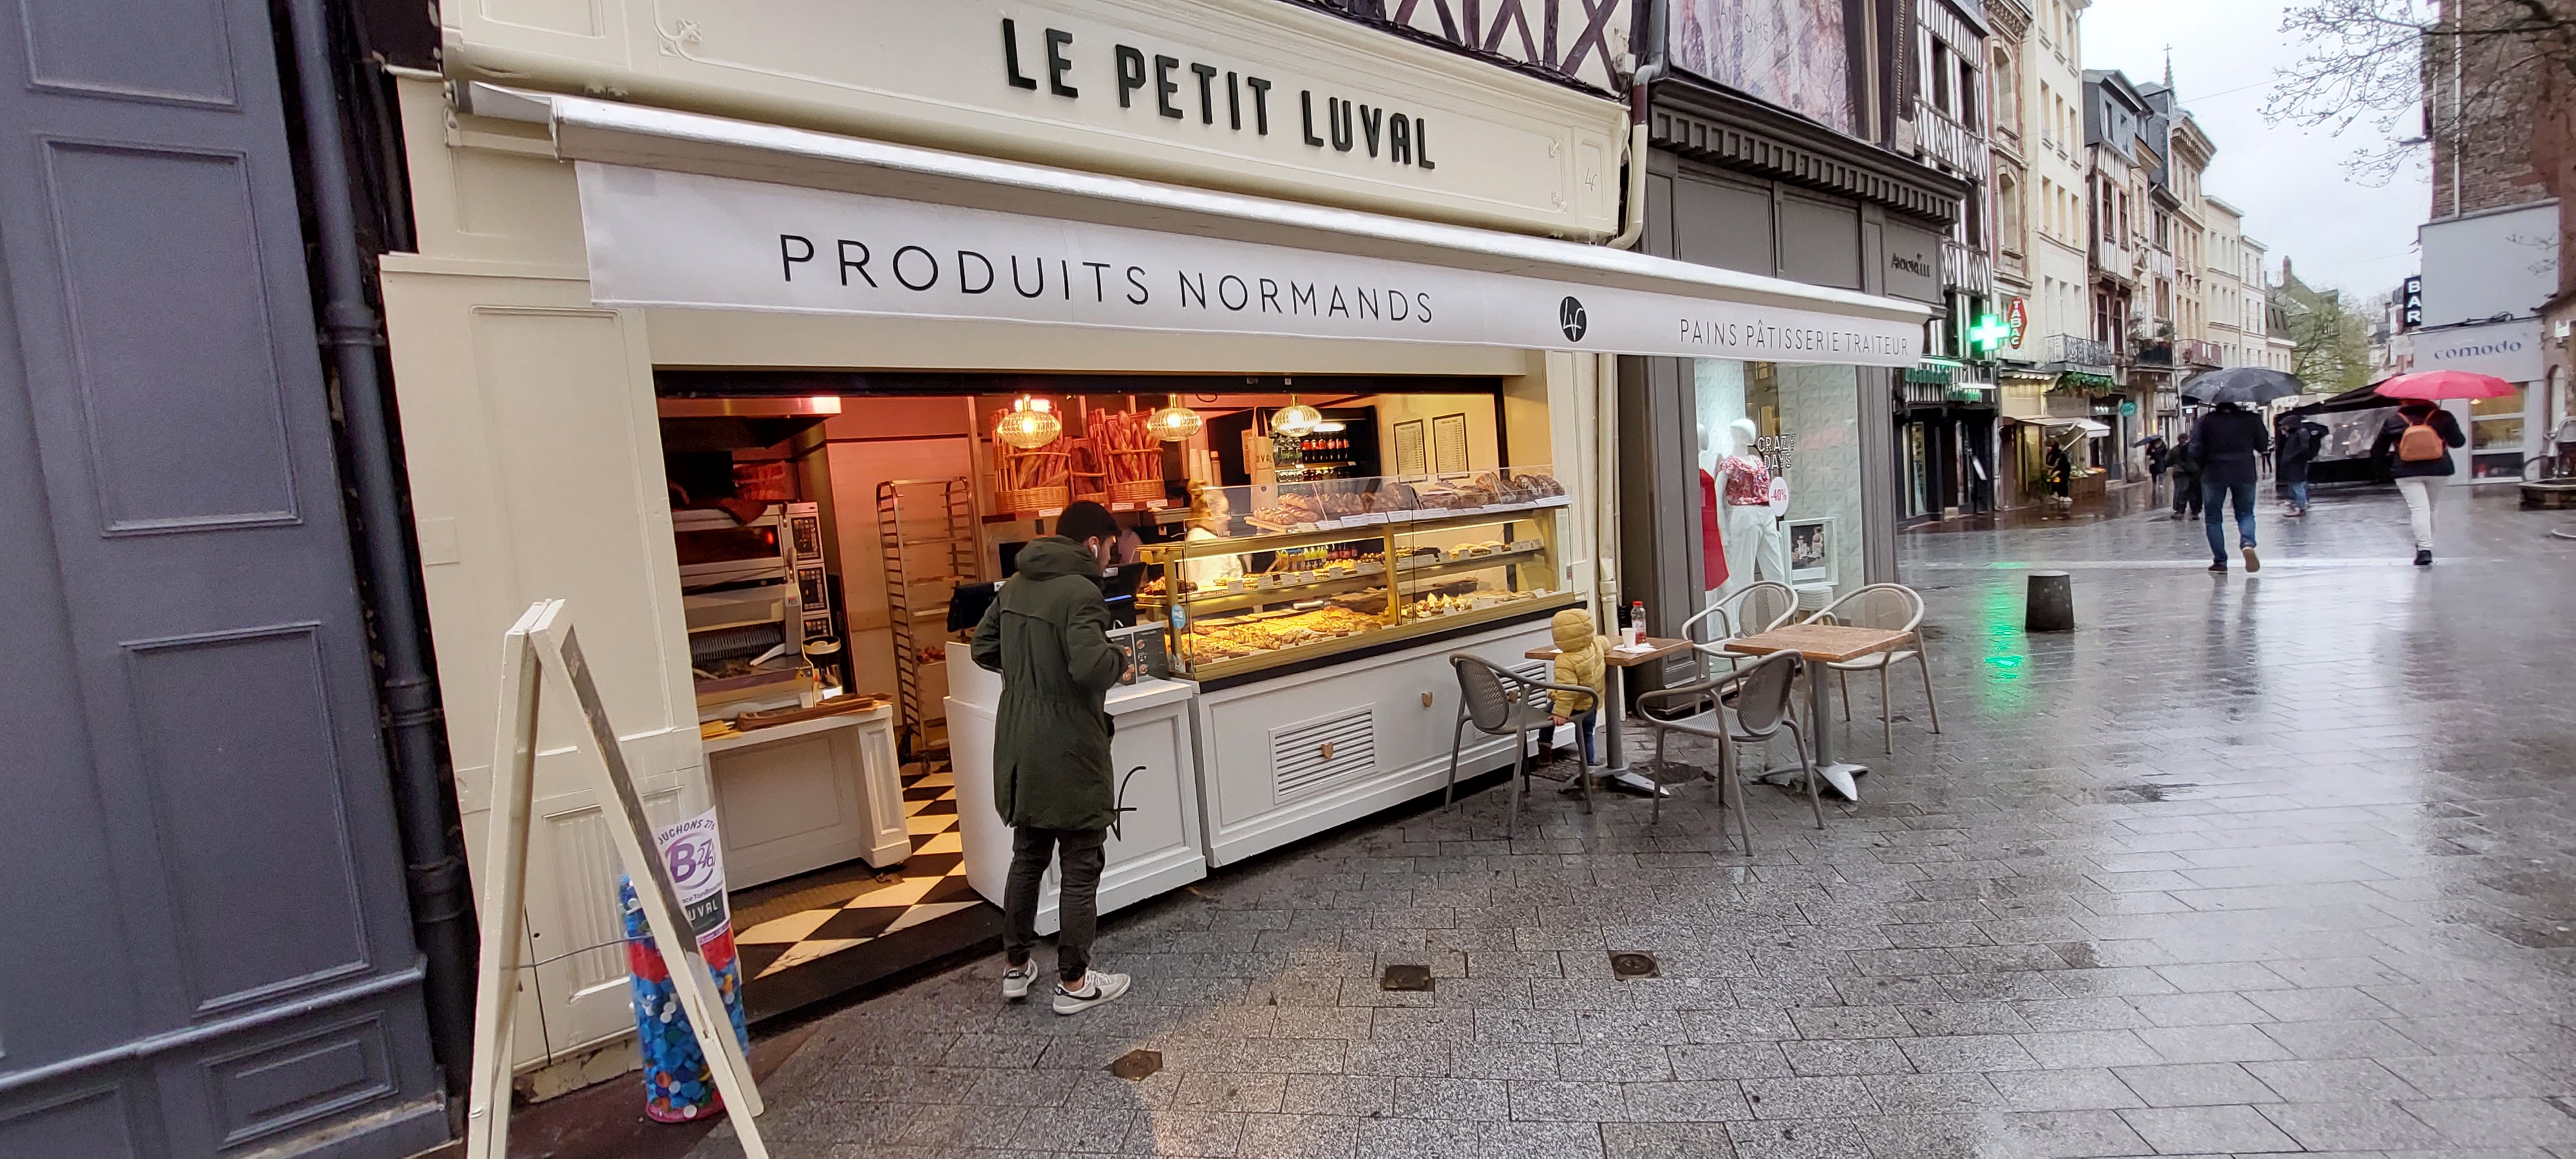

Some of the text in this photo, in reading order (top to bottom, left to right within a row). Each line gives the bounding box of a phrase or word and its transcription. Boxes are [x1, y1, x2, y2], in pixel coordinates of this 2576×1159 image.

[1002, 18, 1436, 171] LE PETIT LUVAL
[780, 234, 1434, 324] PRODUITS NORMANDS
[2407, 281, 2421, 323] BAR
[1680, 318, 1908, 357] PAINS PÂTISSERIE TRAITEUR
[2011, 301, 2022, 345] TABAC
[2434, 340, 2522, 359] comodo
[1757, 434, 1795, 453] CRAZY
[1763, 453, 1792, 471] DAYS
[1770, 488, 1787, 502] -40%
